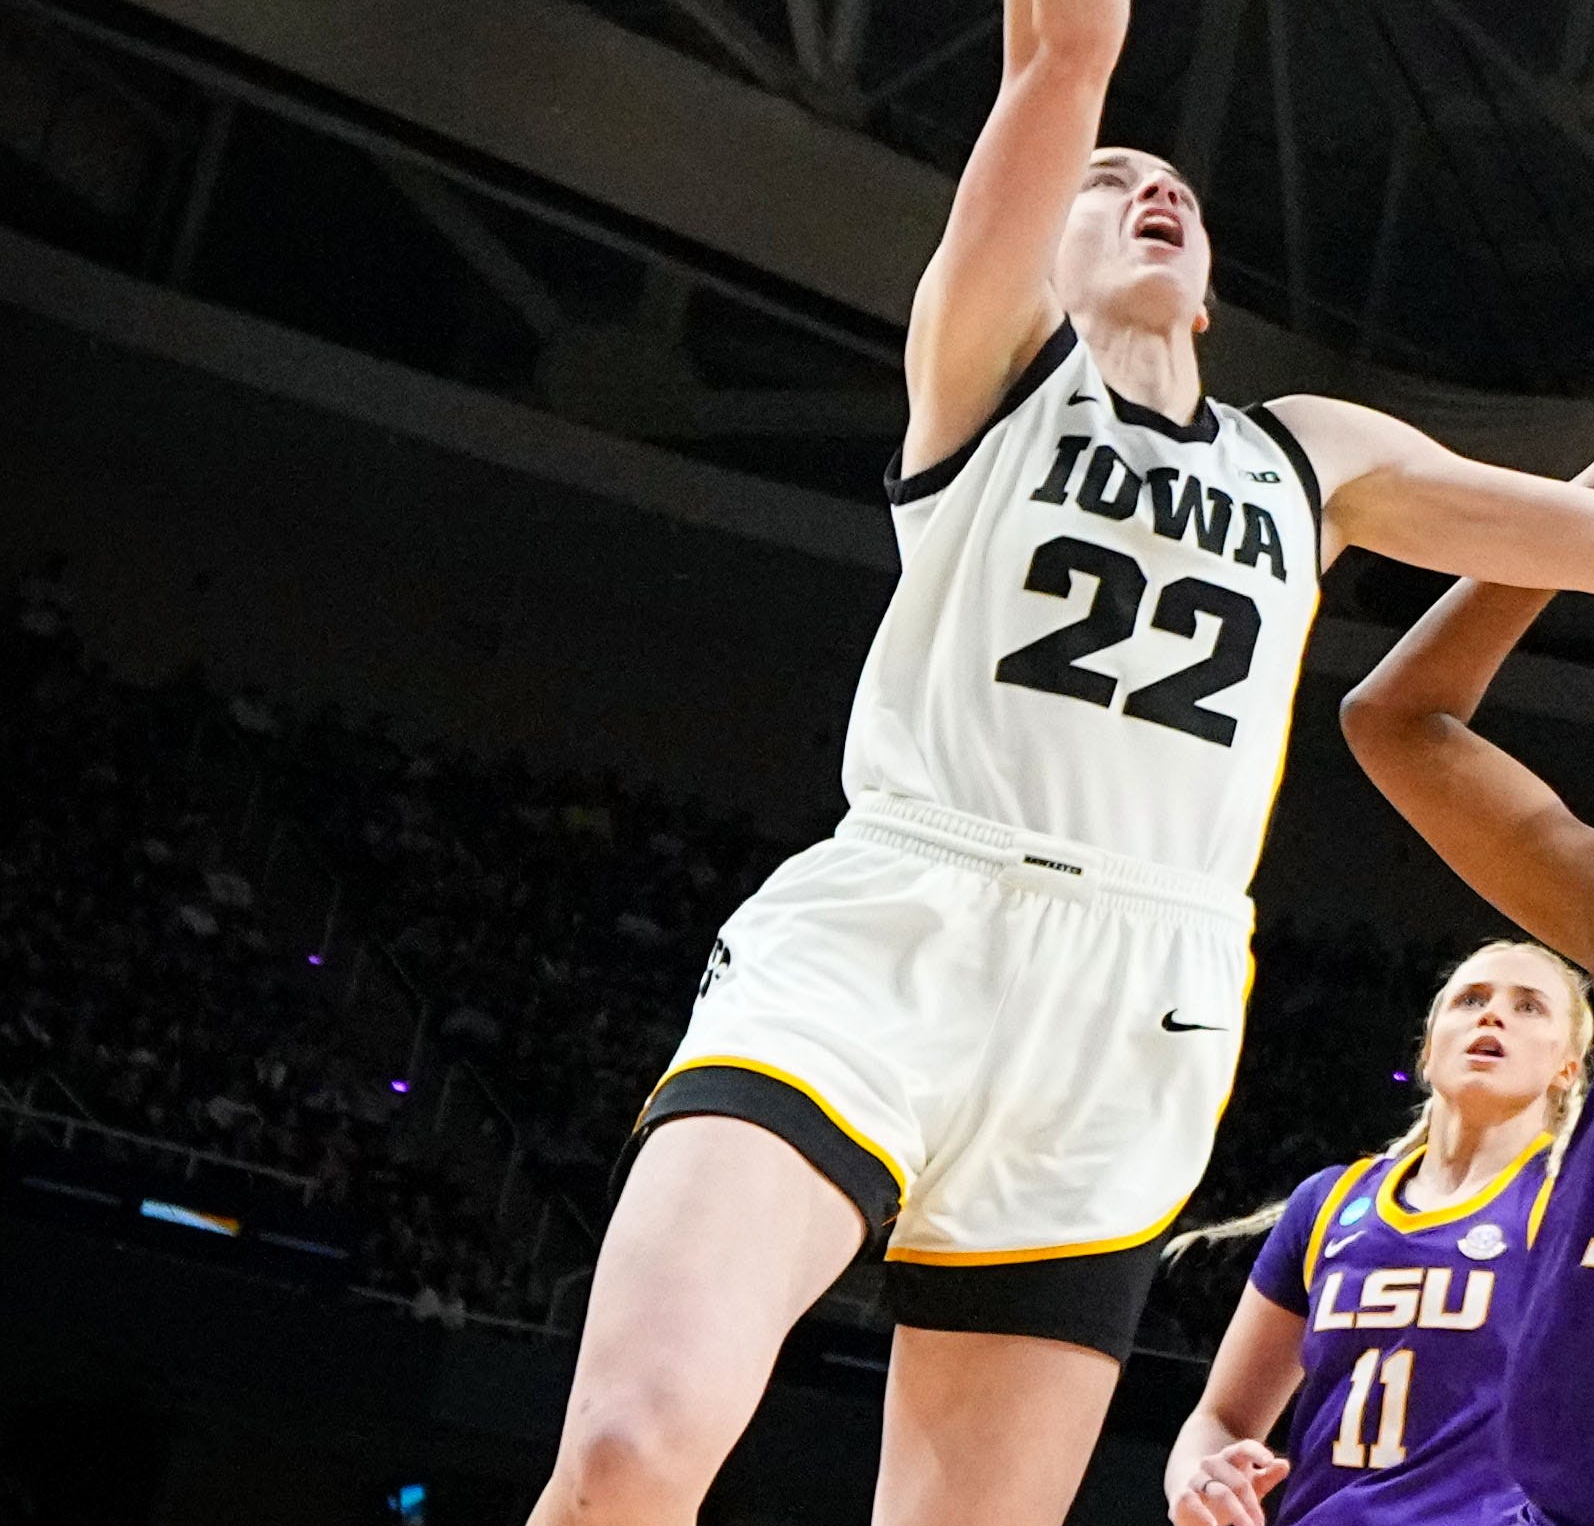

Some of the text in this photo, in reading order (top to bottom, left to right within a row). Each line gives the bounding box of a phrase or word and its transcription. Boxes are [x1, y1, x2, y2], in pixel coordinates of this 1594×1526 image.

[1028, 434, 1288, 584] IOWA
[994, 534, 1263, 749] 22
[1313, 1268, 1495, 1332] LSU
[1331, 1348, 1416, 1470] 11
